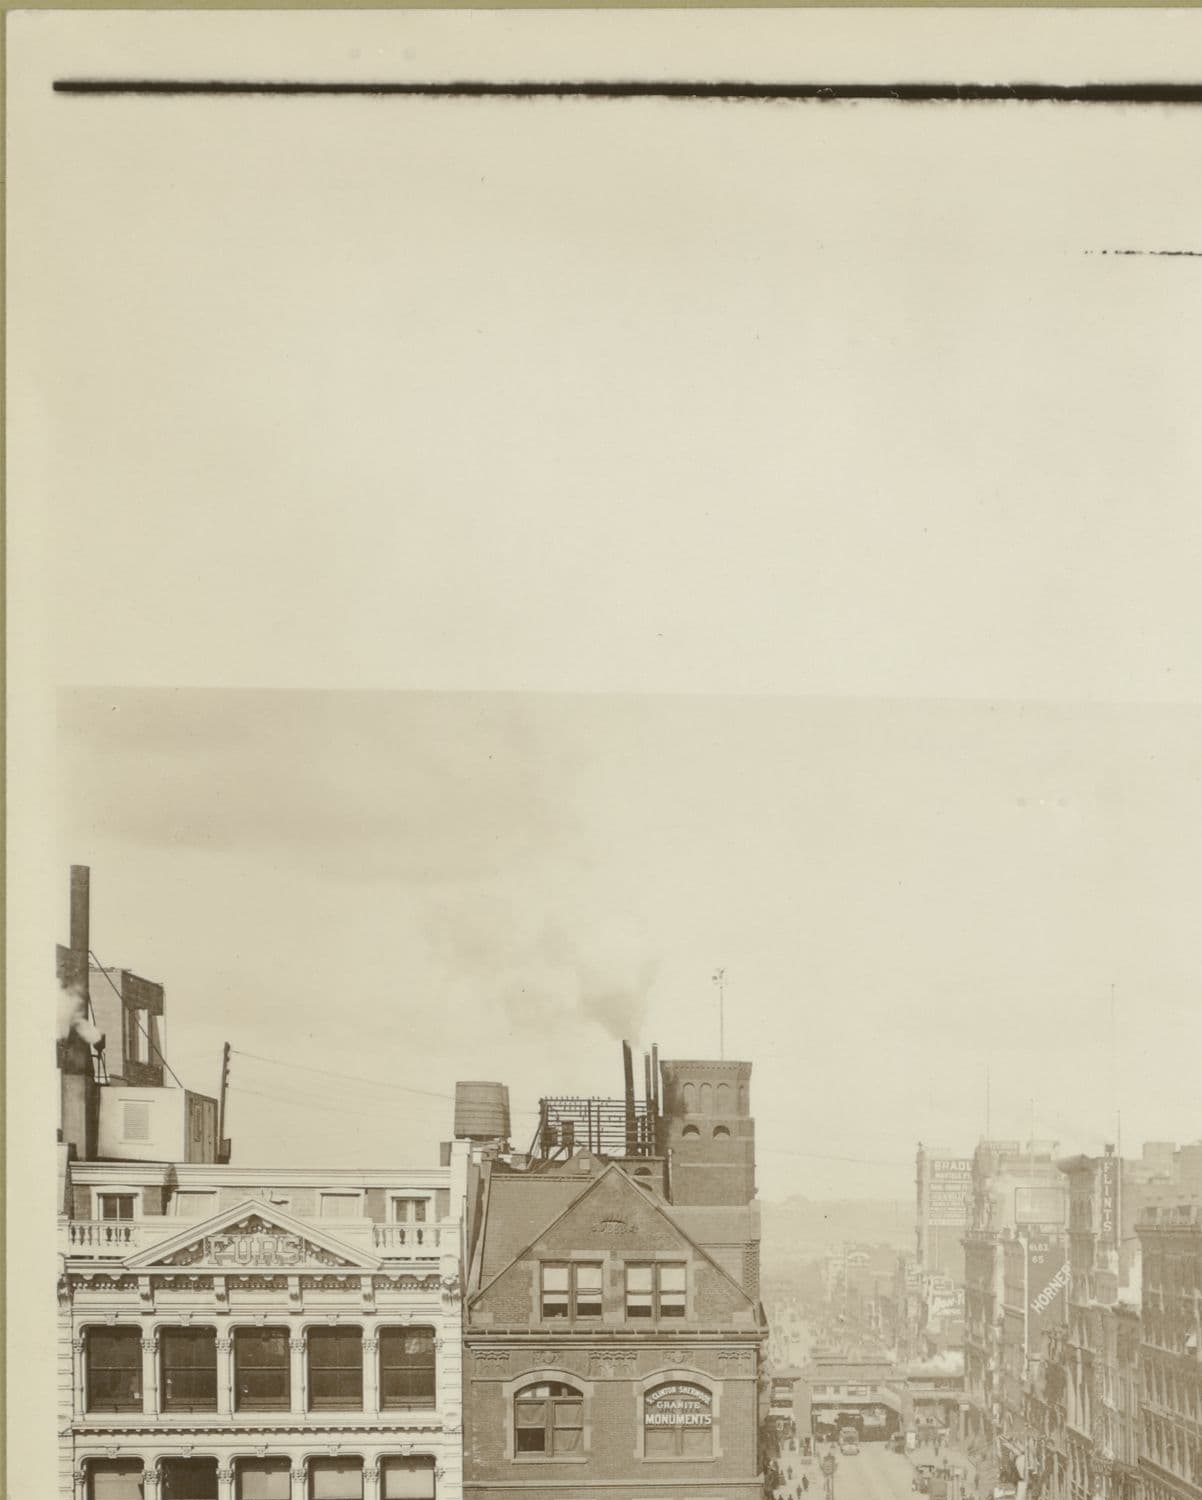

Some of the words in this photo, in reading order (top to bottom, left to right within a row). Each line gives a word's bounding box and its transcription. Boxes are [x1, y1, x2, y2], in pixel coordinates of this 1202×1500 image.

[207, 1236, 301, 1265] FURS
[656, 1401, 702, 1409] GRANITE
[645, 1413, 713, 1425] MONUMENTS
